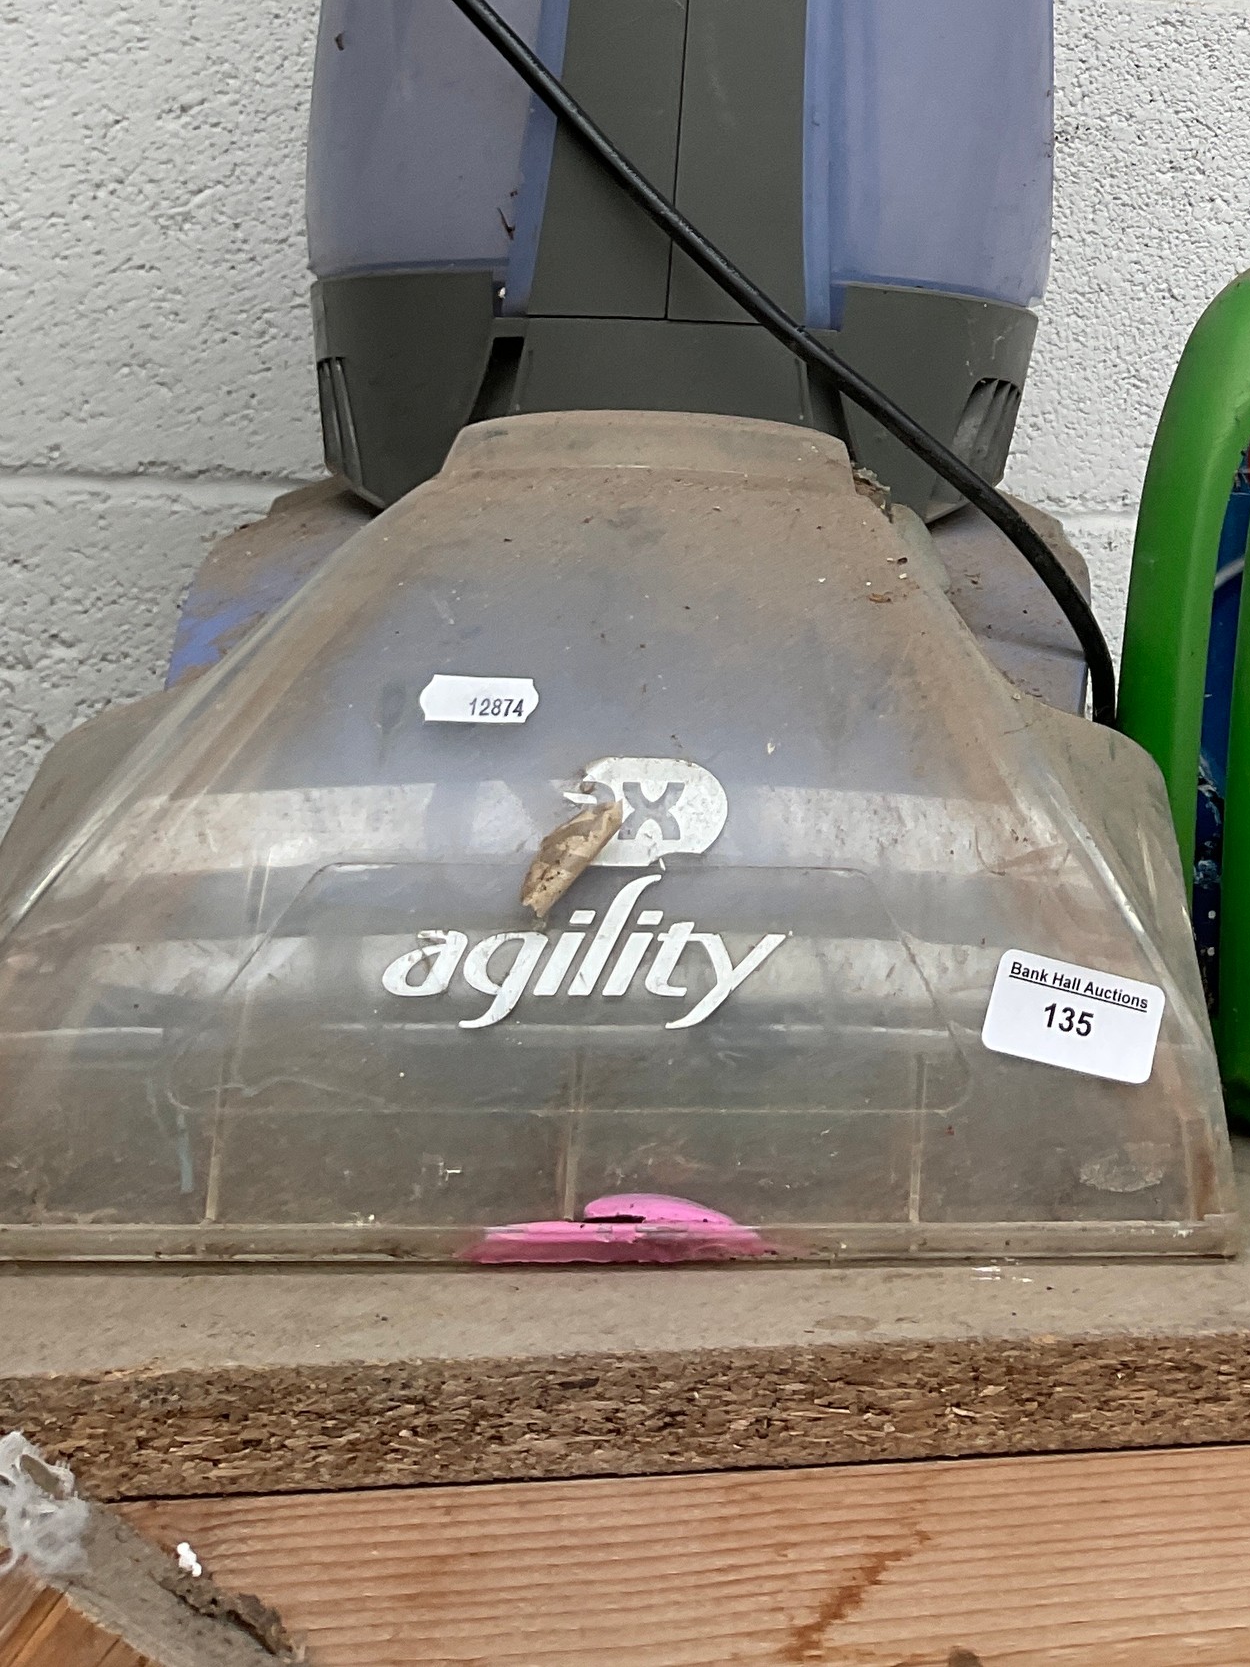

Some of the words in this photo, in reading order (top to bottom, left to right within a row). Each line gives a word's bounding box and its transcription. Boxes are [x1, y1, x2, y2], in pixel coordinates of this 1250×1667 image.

[469, 698, 525, 717] 12874
[382, 874, 788, 1029] agility
[1010, 961, 1049, 983] Bank
[1052, 972, 1081, 992] Hall
[1084, 981, 1148, 1009] Auctions
[1044, 1003, 1094, 1037] 135
